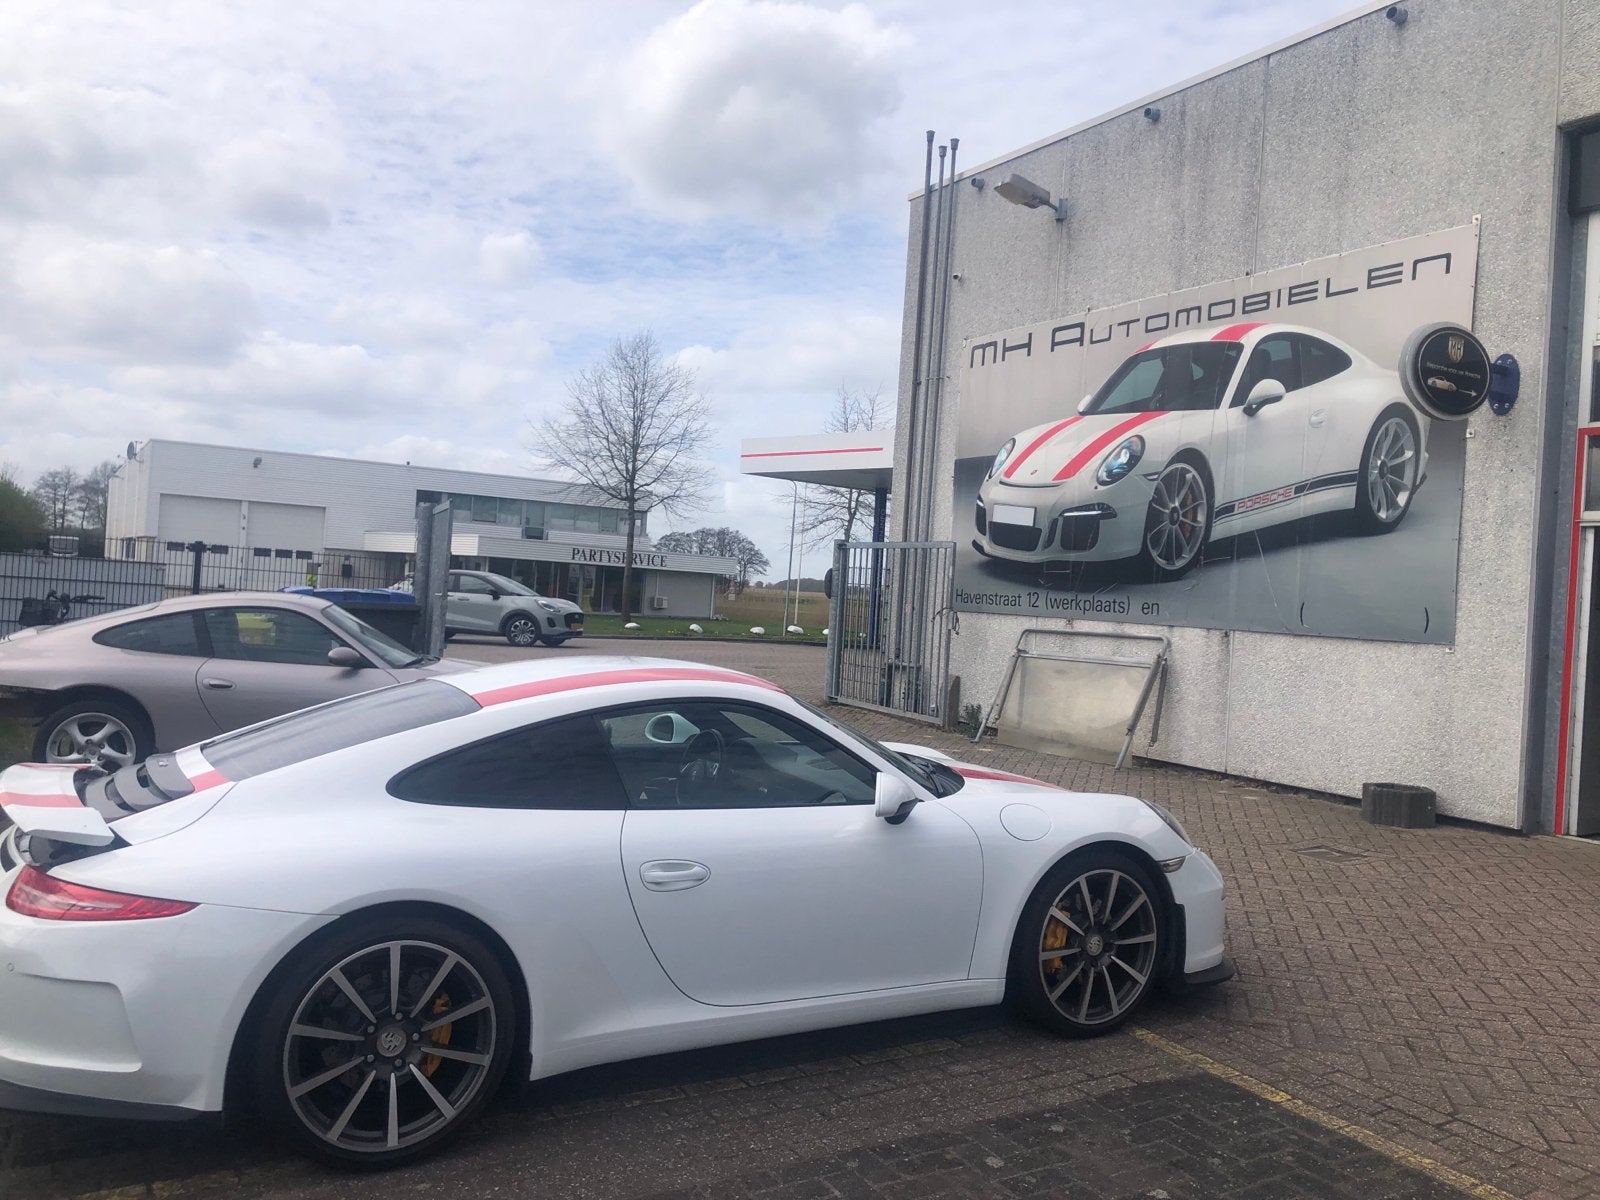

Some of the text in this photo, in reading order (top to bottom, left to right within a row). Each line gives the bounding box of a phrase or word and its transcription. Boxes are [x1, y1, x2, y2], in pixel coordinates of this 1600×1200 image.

[1237, 487, 1294, 512] PORSCHE
[955, 588, 1022, 607] Havenstraat
[1027, 591, 1040, 608] 12
[1045, 591, 1131, 615] (werkplaats)
[1141, 601, 1160, 615] en
